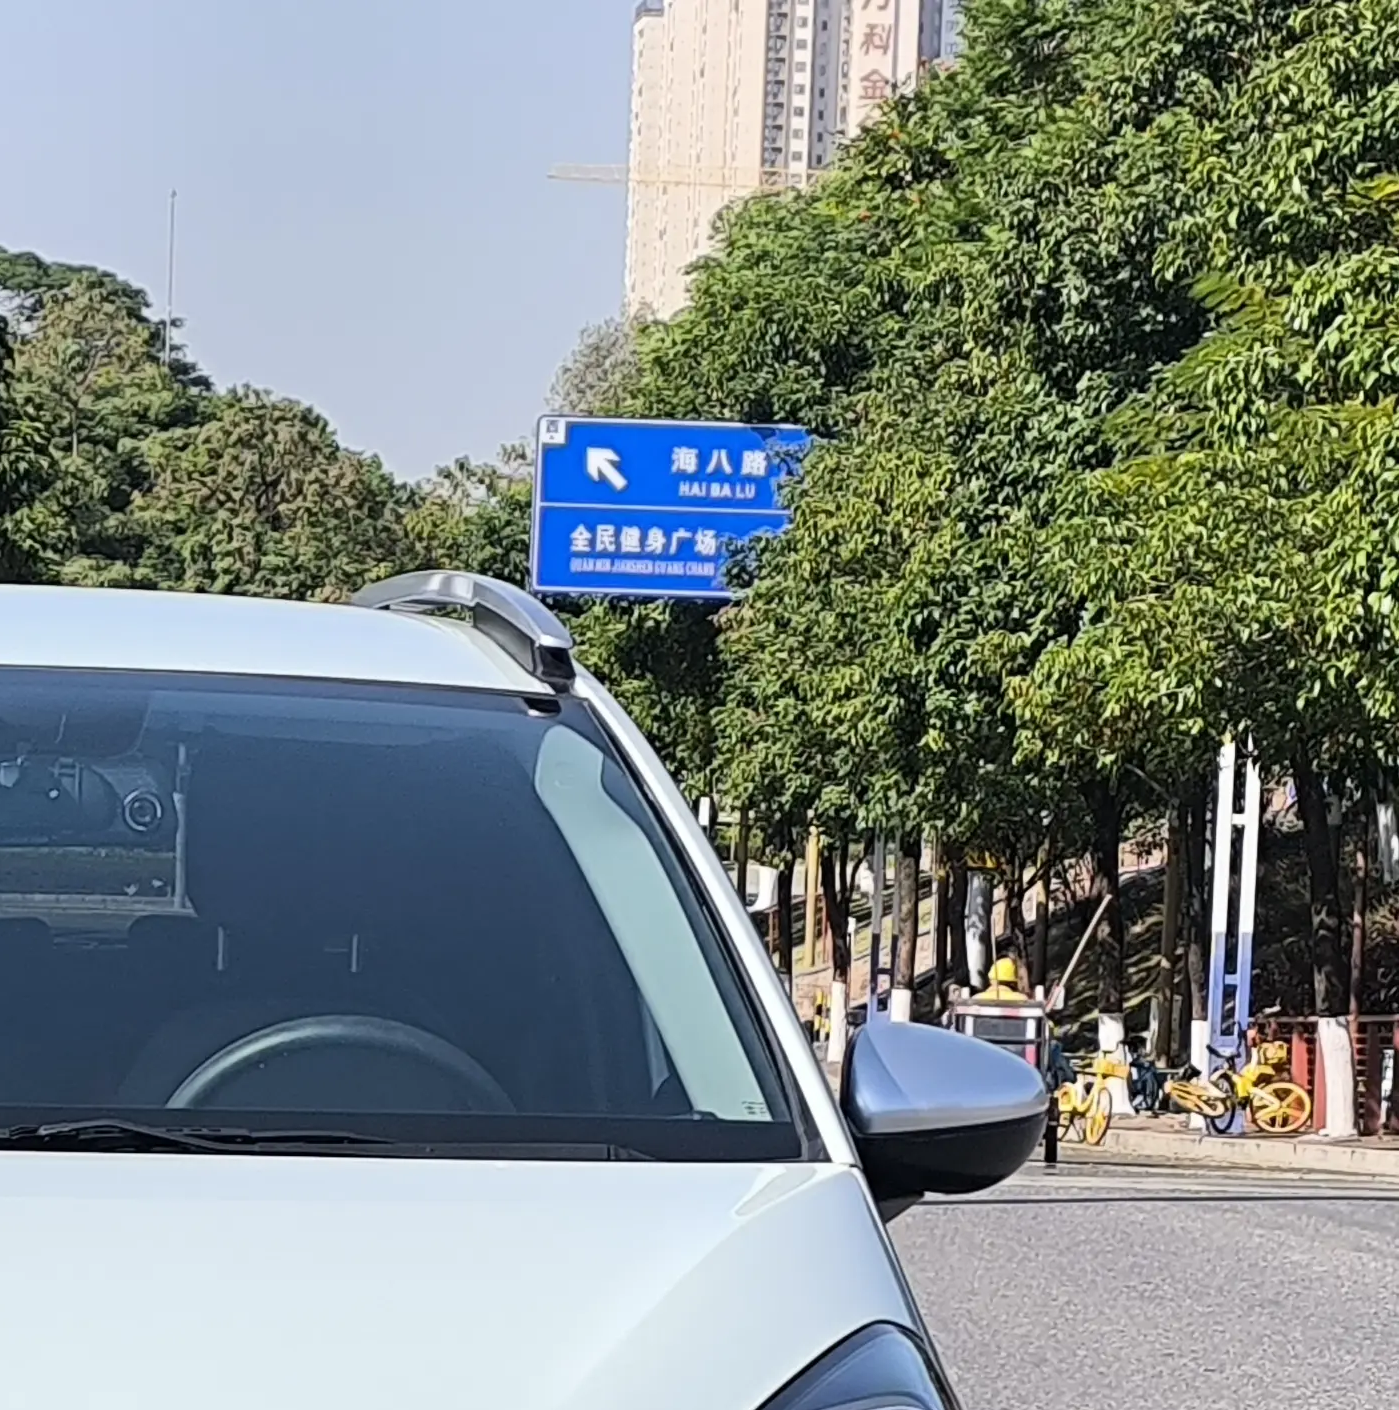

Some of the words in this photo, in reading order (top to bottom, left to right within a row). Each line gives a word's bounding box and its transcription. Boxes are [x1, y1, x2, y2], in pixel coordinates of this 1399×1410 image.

[671, 446, 766, 476] 海八路
[679, 481, 706, 497] HAI
[736, 483, 755, 499] LU
[570, 524, 716, 555] 全民健身广场
